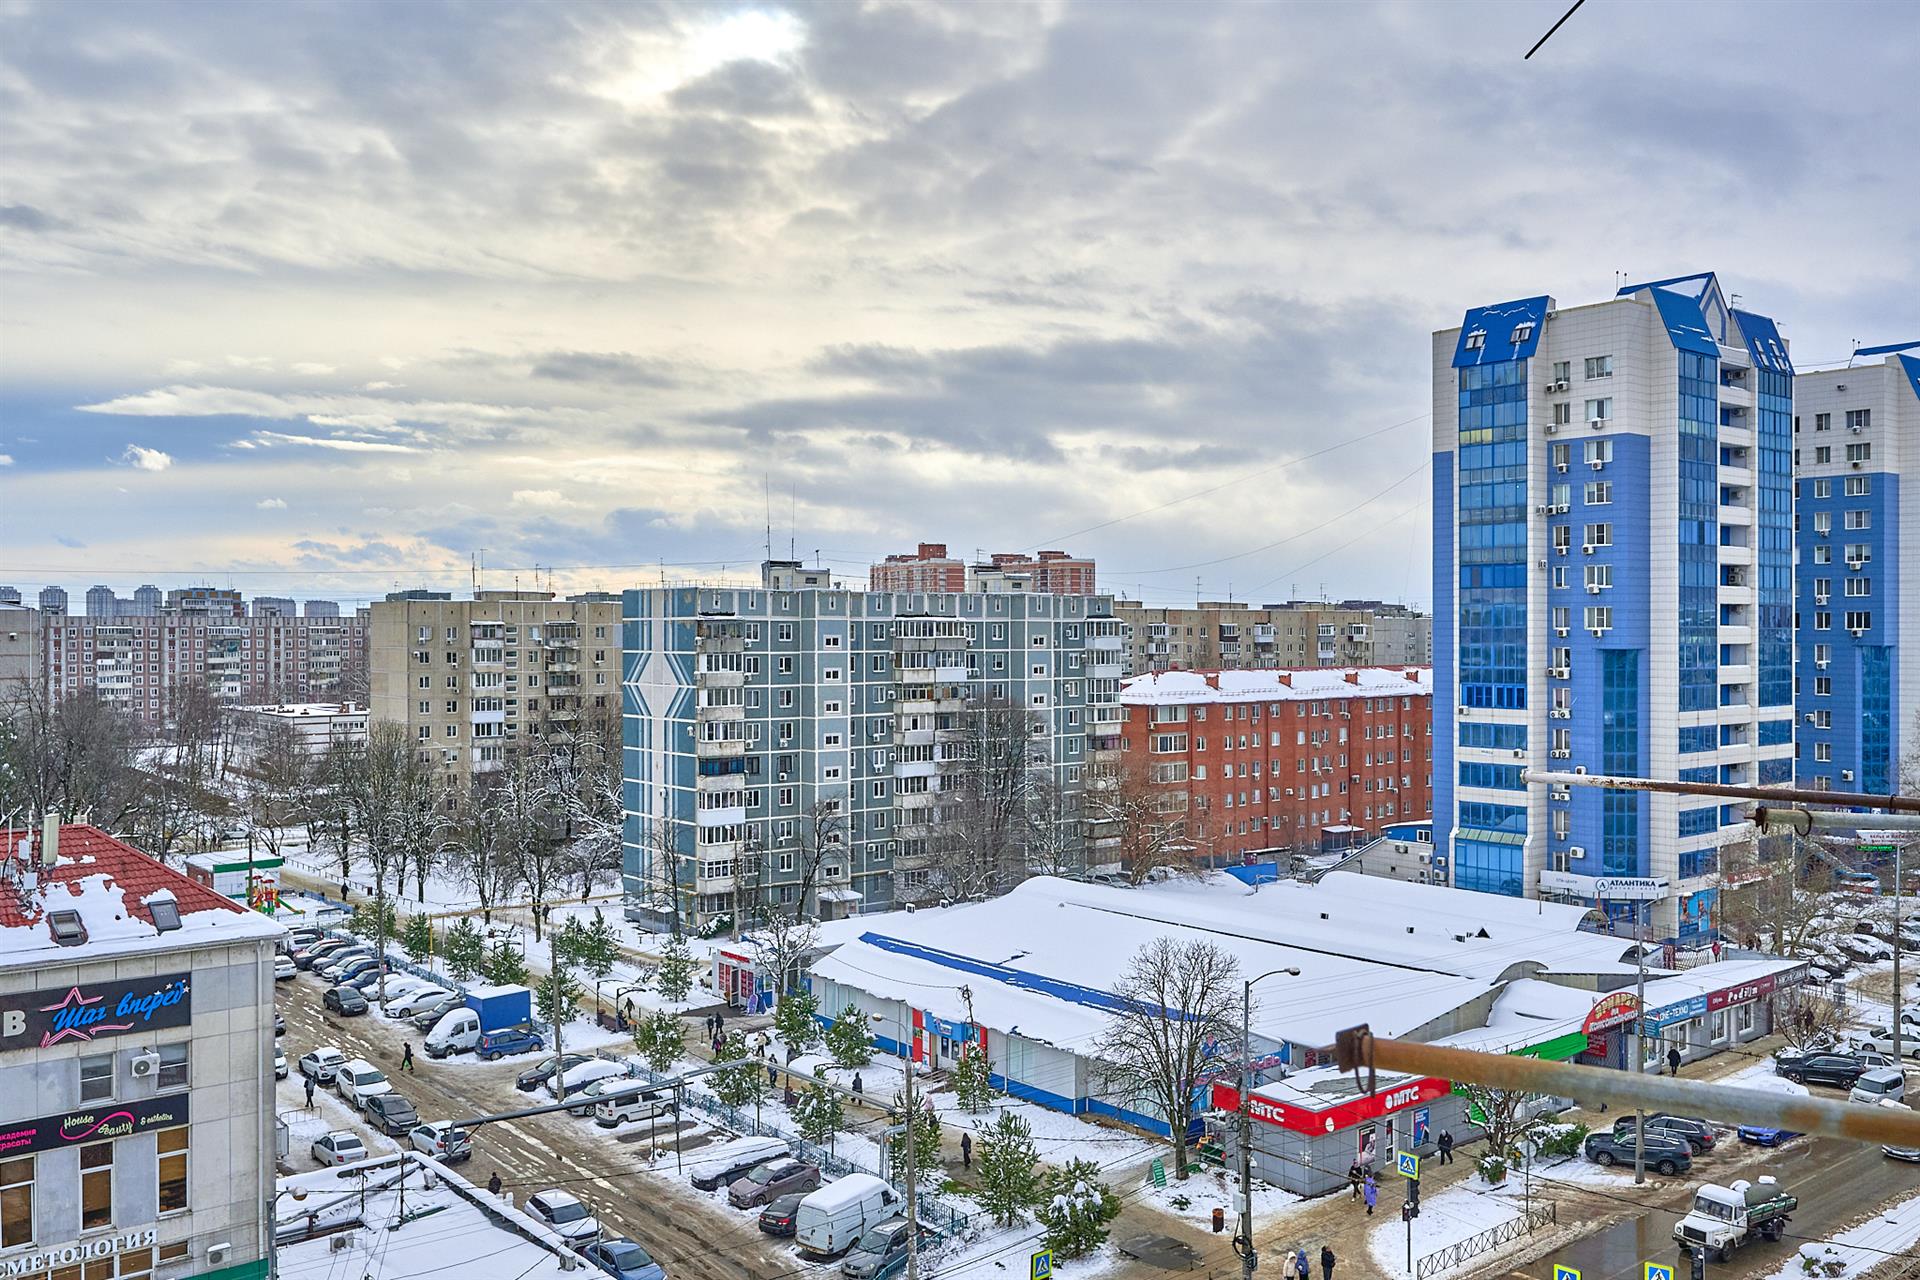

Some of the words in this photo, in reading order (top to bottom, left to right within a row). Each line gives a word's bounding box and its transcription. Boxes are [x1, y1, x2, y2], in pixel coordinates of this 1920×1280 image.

[3, 1010, 26, 1037] В
[53, 1007, 107, 1031] Шаг
[1393, 1086, 1419, 1107] МТС
[64, 1115, 95, 1129] House
[1257, 1102, 1285, 1122] МТС
